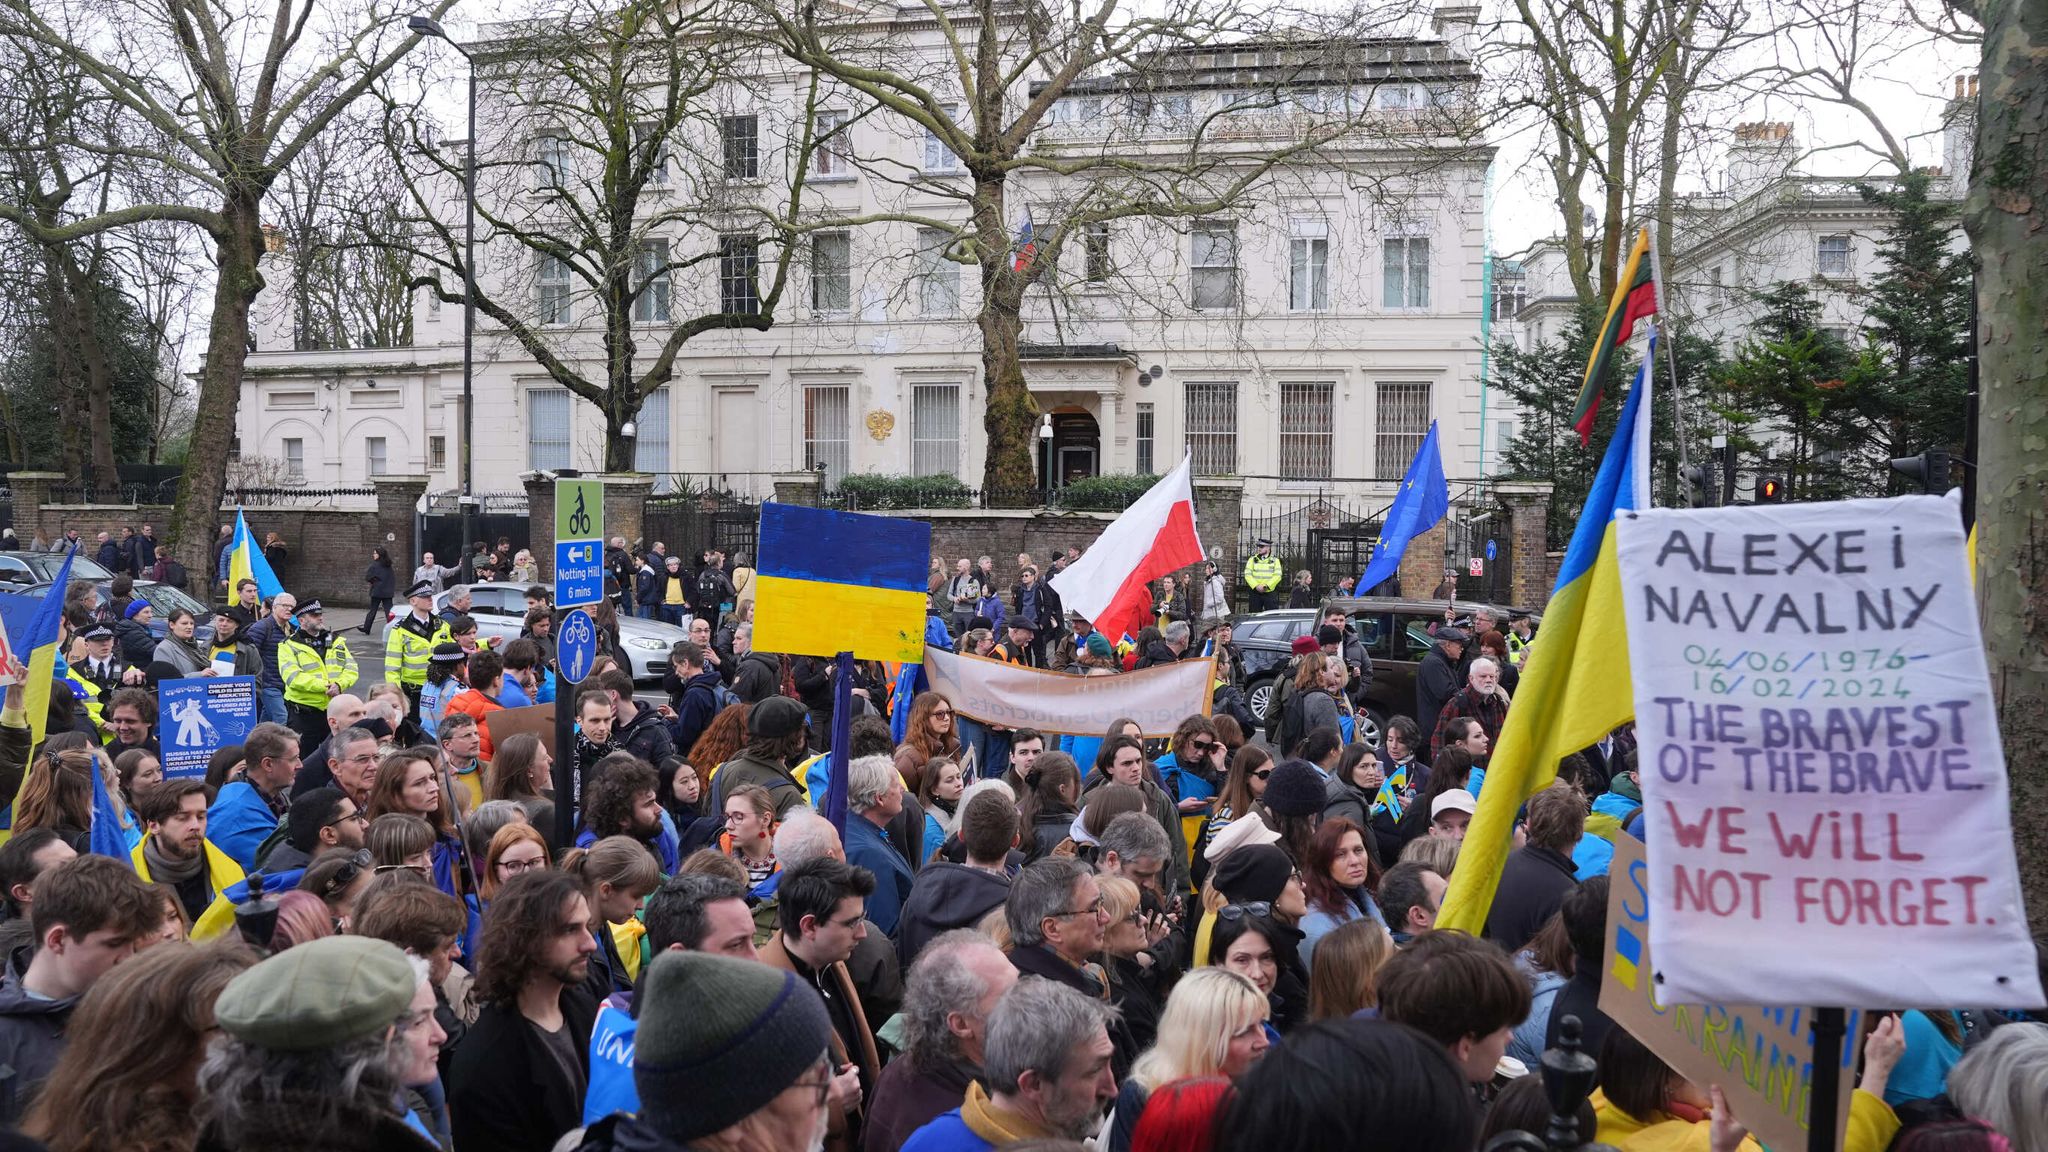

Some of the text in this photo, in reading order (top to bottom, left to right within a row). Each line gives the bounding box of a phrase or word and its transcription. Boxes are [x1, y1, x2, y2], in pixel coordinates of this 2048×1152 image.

[558, 565, 600, 581] Notting Hill
[568, 586, 592, 598] 6 mins
[1643, 583, 1941, 634] NAVALNY
[1654, 697, 1971, 751] THE BRAVEST
[1657, 743, 1715, 785] OF
[1732, 748, 1820, 794] THE
[1665, 800, 1748, 855] WE
[1673, 863, 1772, 920] NOT
[1794, 875, 1996, 927] FORGET.
